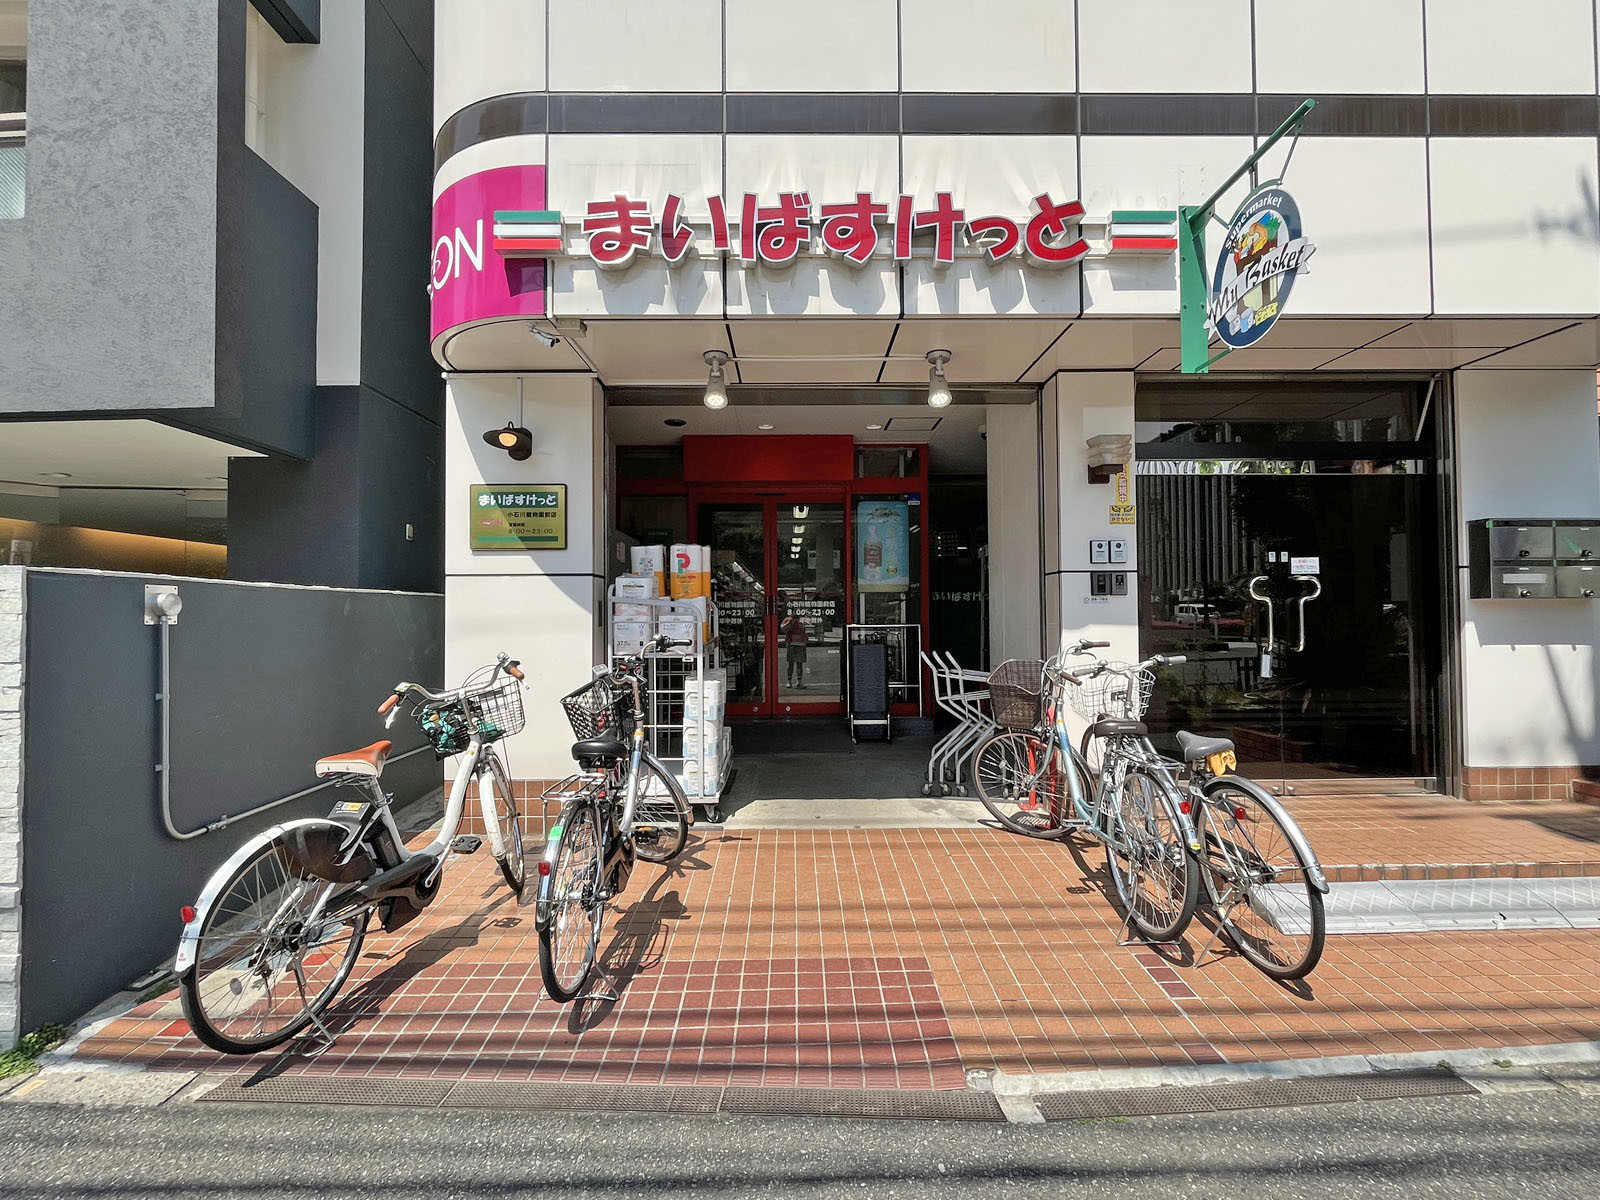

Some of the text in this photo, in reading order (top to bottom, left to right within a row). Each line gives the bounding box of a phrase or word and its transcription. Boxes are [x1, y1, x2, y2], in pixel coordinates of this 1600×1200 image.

[581, 191, 1089, 271] まいばすけっと
[1225, 193, 1282, 251] Supermarket
[1208, 244, 1307, 324] My Basket
[478, 495, 557, 506] まいばすけっと
